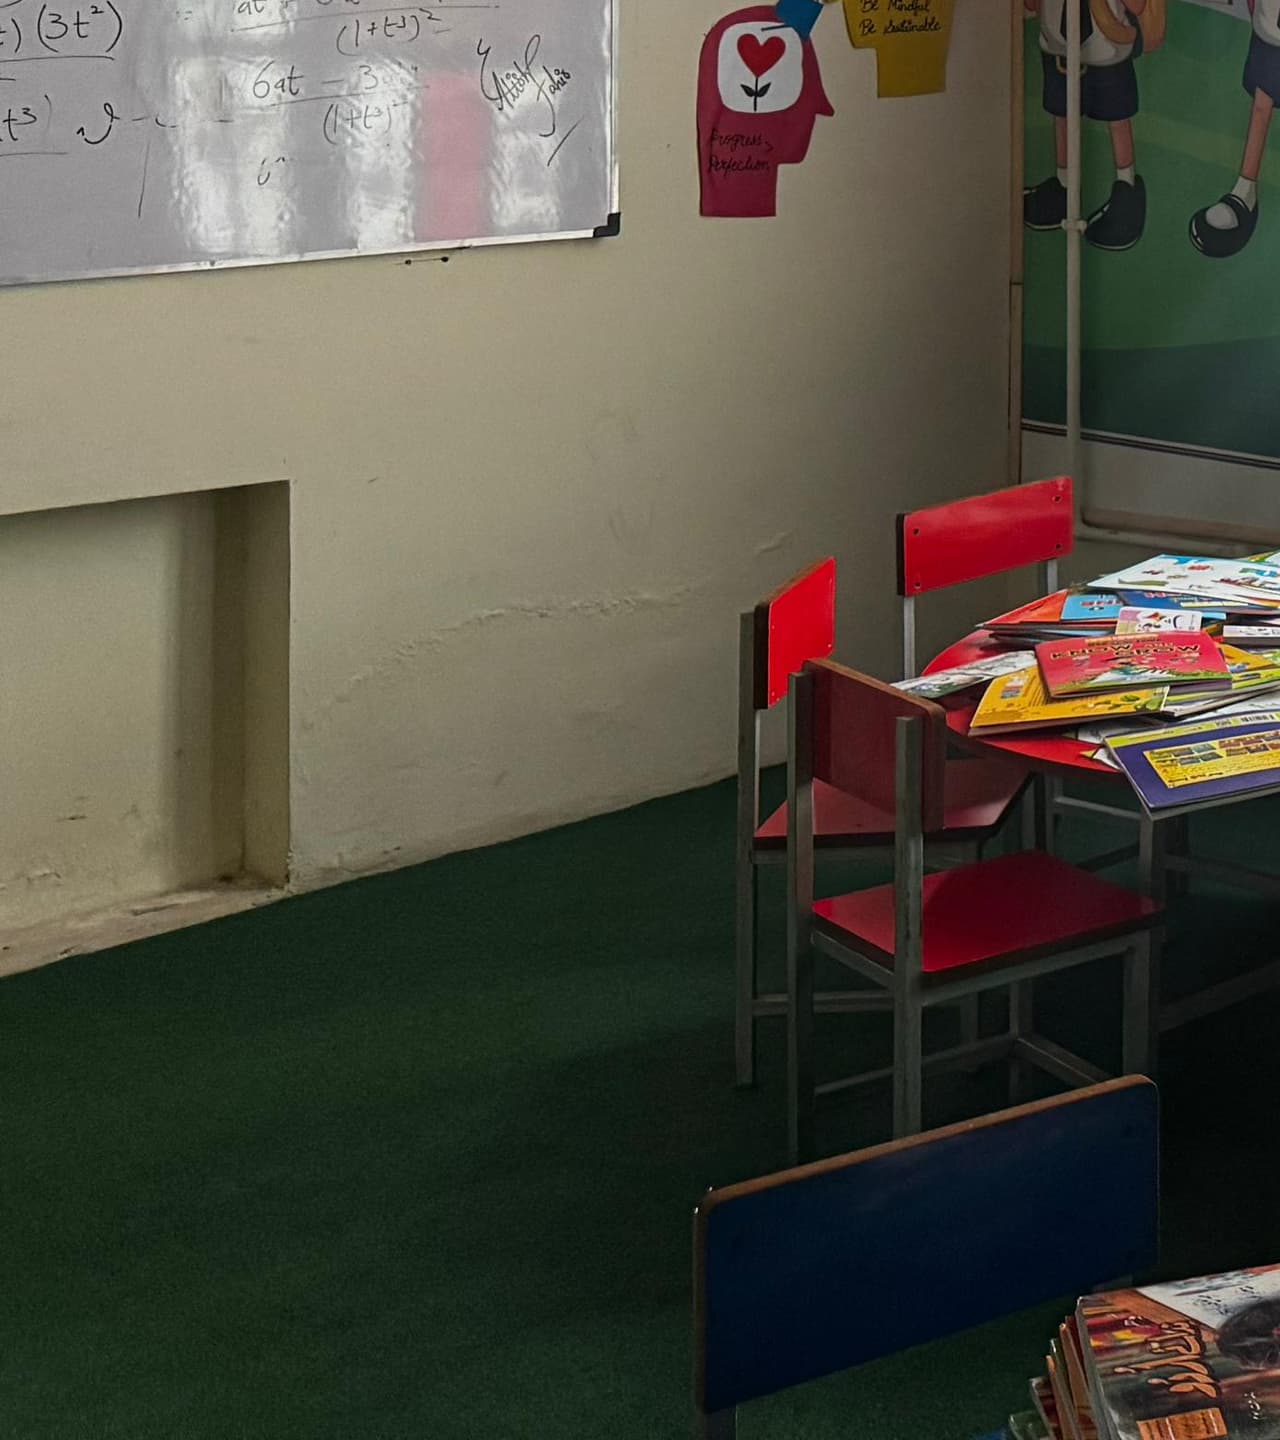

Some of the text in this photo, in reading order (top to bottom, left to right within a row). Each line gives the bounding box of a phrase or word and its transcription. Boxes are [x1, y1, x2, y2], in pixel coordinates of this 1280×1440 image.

[860, 19, 876, 36] Be
[1050, 643, 1132, 659] KNOW
[1114, 644, 1200, 657] GROW
